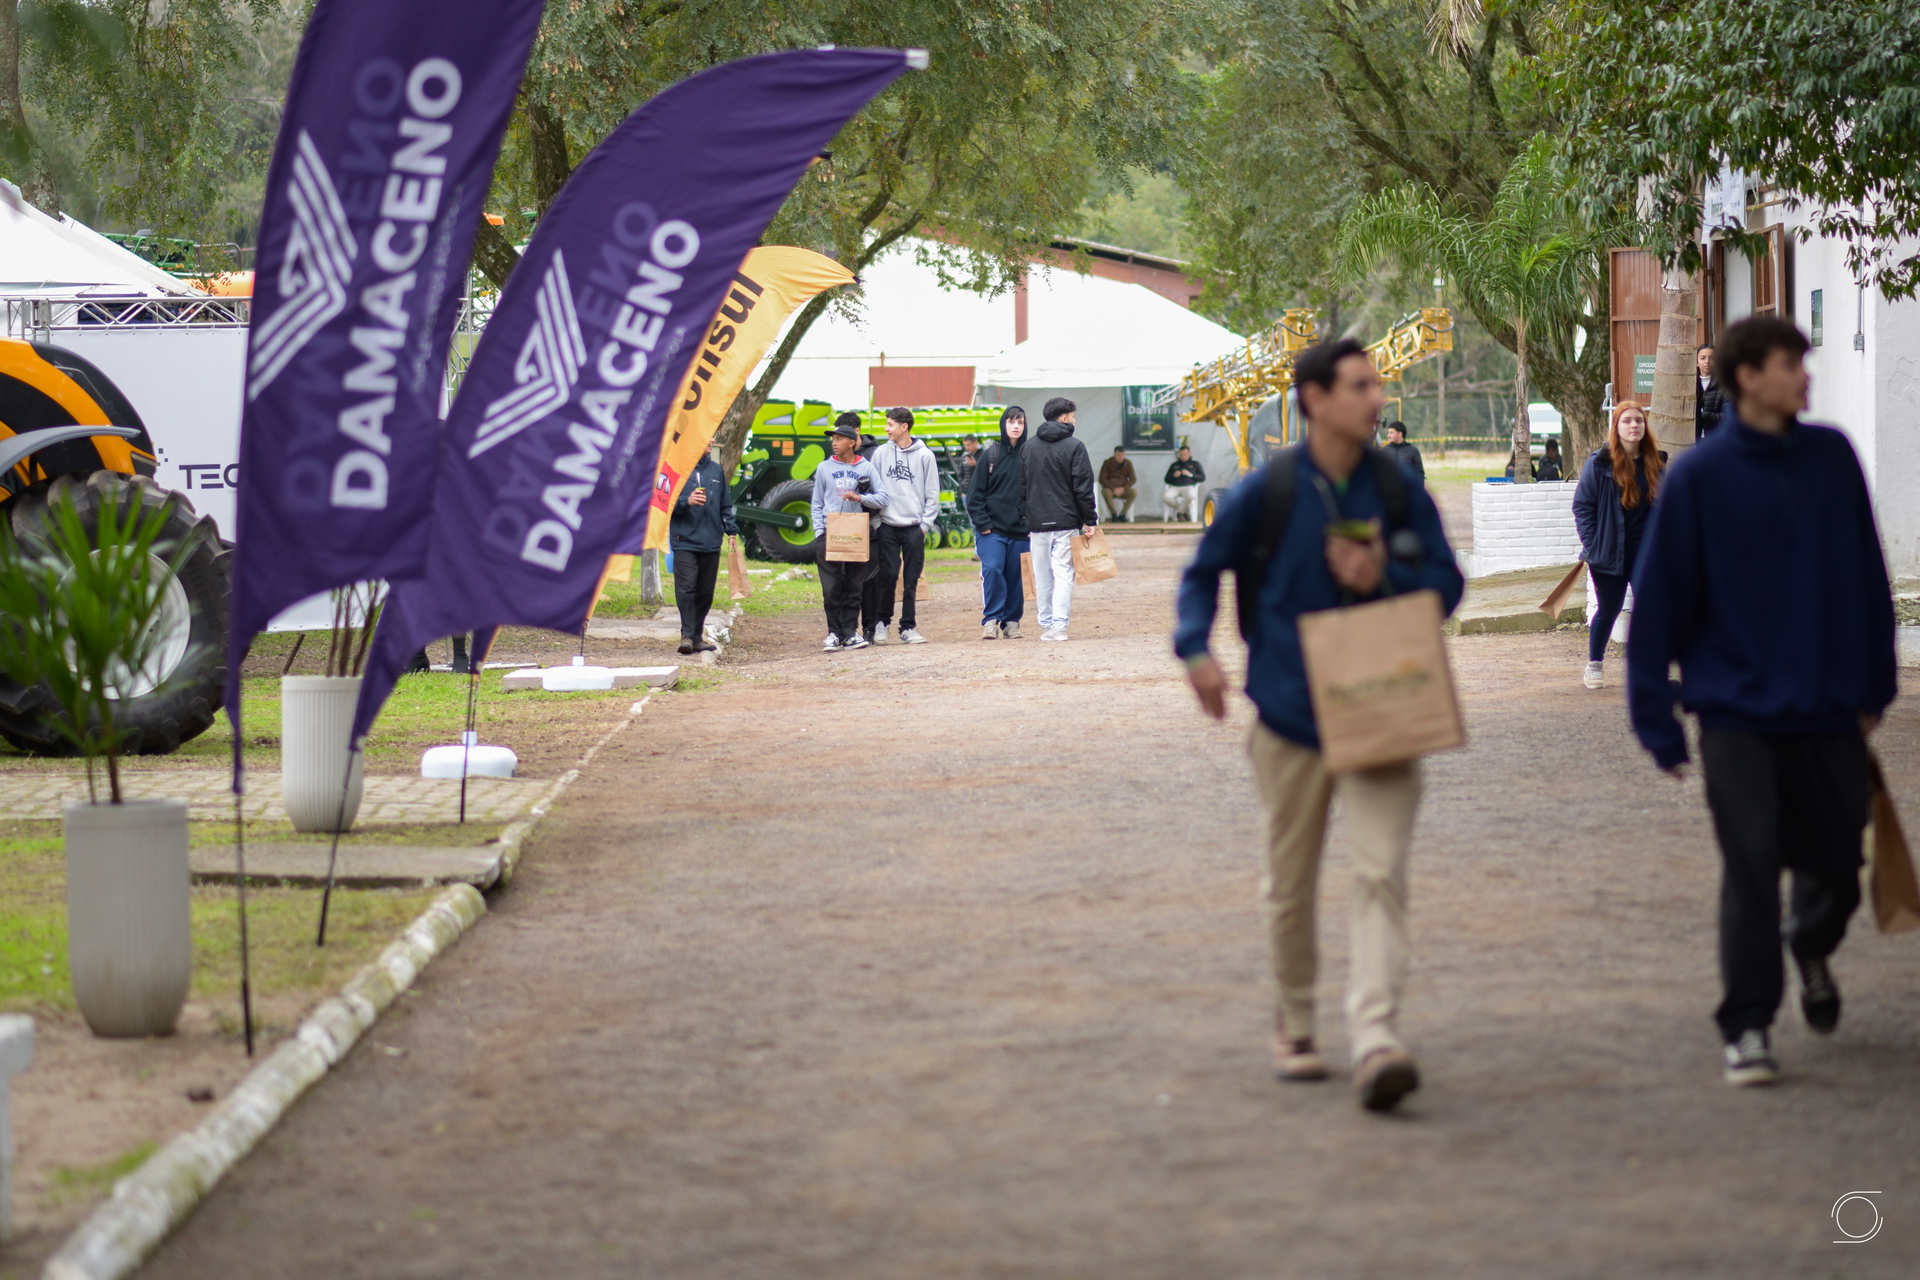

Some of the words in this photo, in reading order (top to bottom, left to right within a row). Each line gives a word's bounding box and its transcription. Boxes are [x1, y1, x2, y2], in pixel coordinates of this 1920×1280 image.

[330, 57, 463, 509] DAMACENO
[673, 270, 765, 443] onsul
[521, 220, 700, 571] DAMACENO
[832, 470, 845, 480] NEW
[846, 470, 861, 481] YORK
[836, 479, 856, 488] CITY
